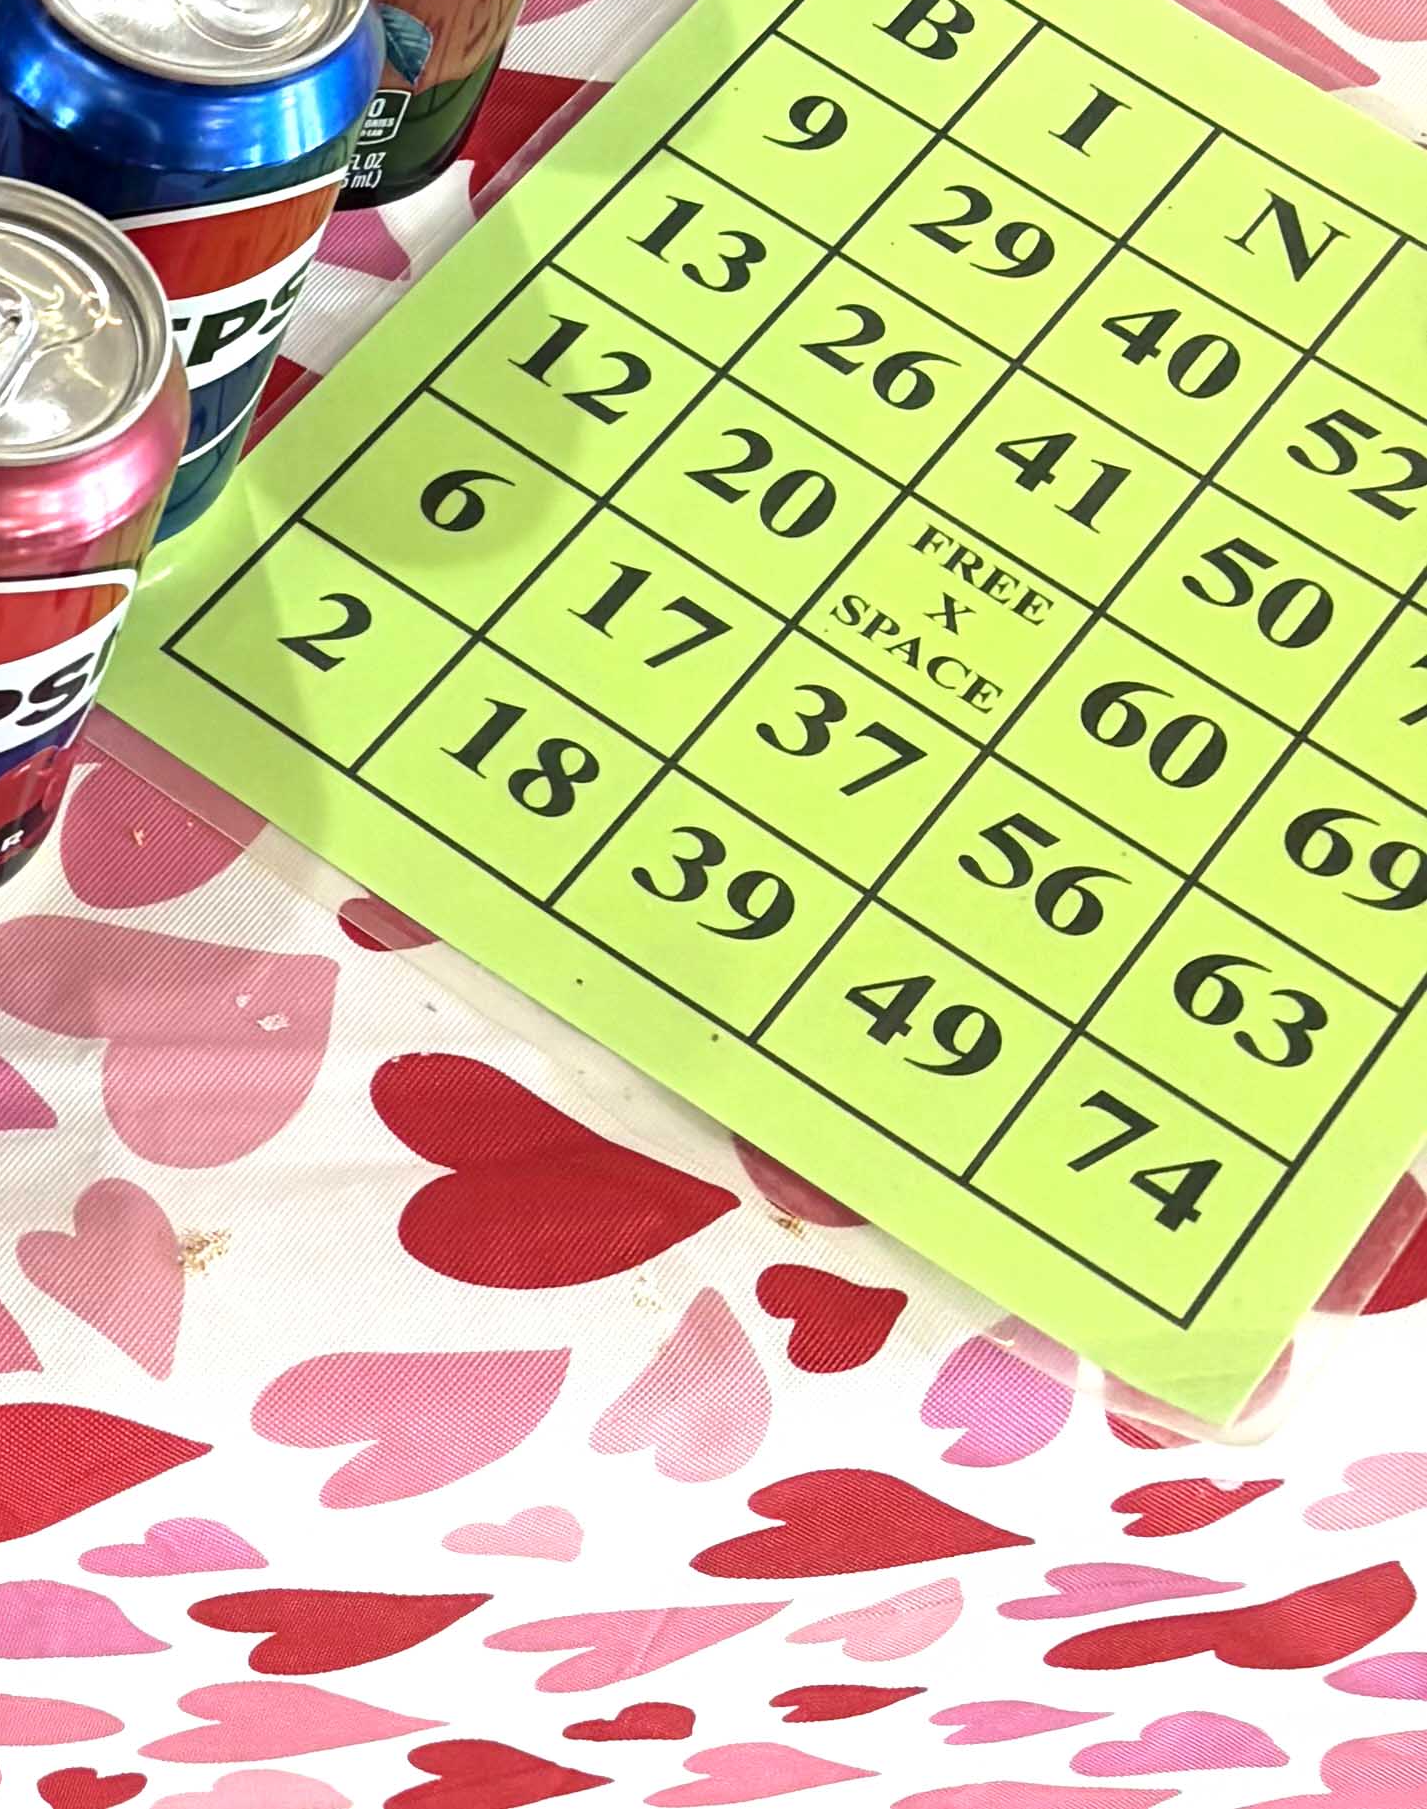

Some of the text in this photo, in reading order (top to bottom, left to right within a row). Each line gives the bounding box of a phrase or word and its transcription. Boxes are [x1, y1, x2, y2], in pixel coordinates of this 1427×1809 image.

[363, 151, 387, 170] OZ
[762, 94, 1427, 521] 9 29 40 52
[1048, 83, 1132, 157] I
[1224, 188, 1351, 282] N
[626, 195, 1334, 649] 13 26 41 50
[907, 523, 1054, 626] FREE
[419, 469, 1328, 1068] 6 17 37 56 63
[507, 314, 1427, 911] 12 20 60 69
[829, 594, 1004, 714] SPACE
[924, 592, 976, 635] X
[276, 592, 1224, 1233] 2 18 39 49 74
